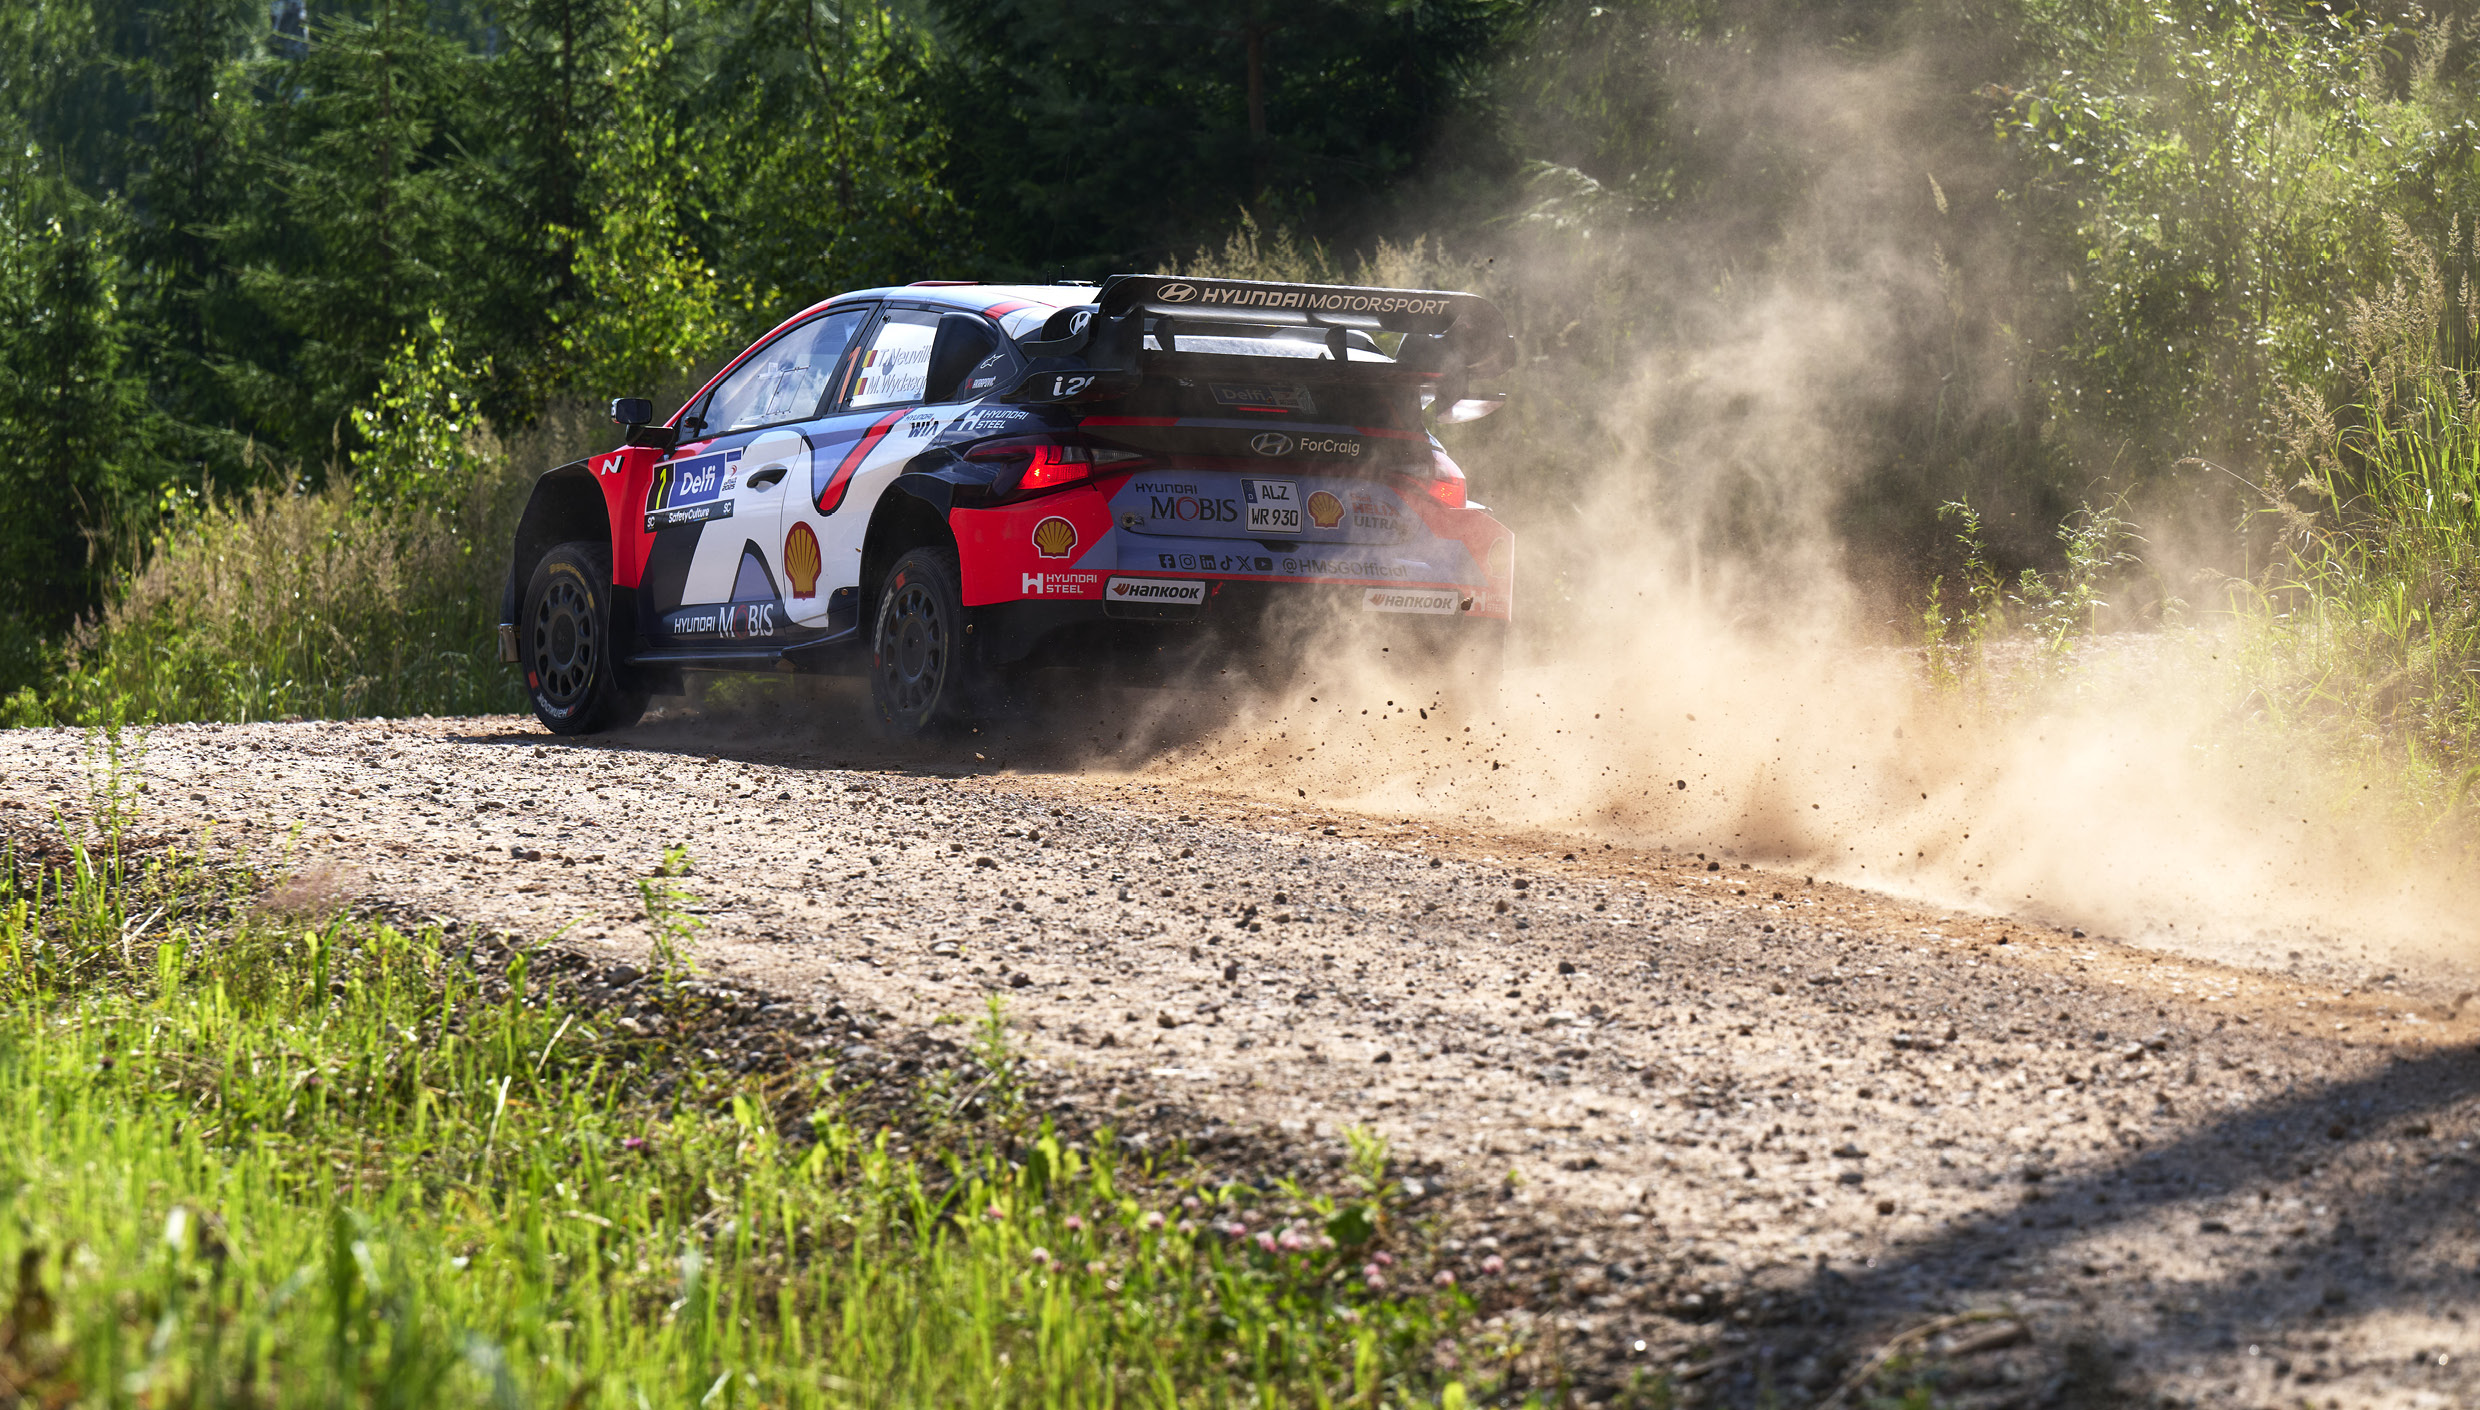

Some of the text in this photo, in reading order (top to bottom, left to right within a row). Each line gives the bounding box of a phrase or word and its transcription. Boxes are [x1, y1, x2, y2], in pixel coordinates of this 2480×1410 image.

[1201, 287, 1450, 315] HYUNDAI MOTORSPORT
[984, 410, 1030, 421] HYUNDAI
[977, 420, 1005, 430] STEEL
[1300, 438, 1361, 456] ForCraig
[655, 468, 667, 509] 1
[680, 465, 716, 496] Delfi
[1135, 483, 1198, 495] HYUNDAI
[1262, 485, 1290, 500] ALZ
[668, 507, 710, 524] SafetyCulture
[1150, 496, 1238, 522] MOBIS
[1252, 508, 1298, 526] WR 930
[1354, 515, 1398, 530] ULTRA
[1282, 557, 1408, 578] @HMSGOfficial
[1046, 574, 1098, 583] HYUNDAI
[1046, 584, 1082, 593] STEEL
[674, 603, 774, 639] HYUNDAI MOBIS
